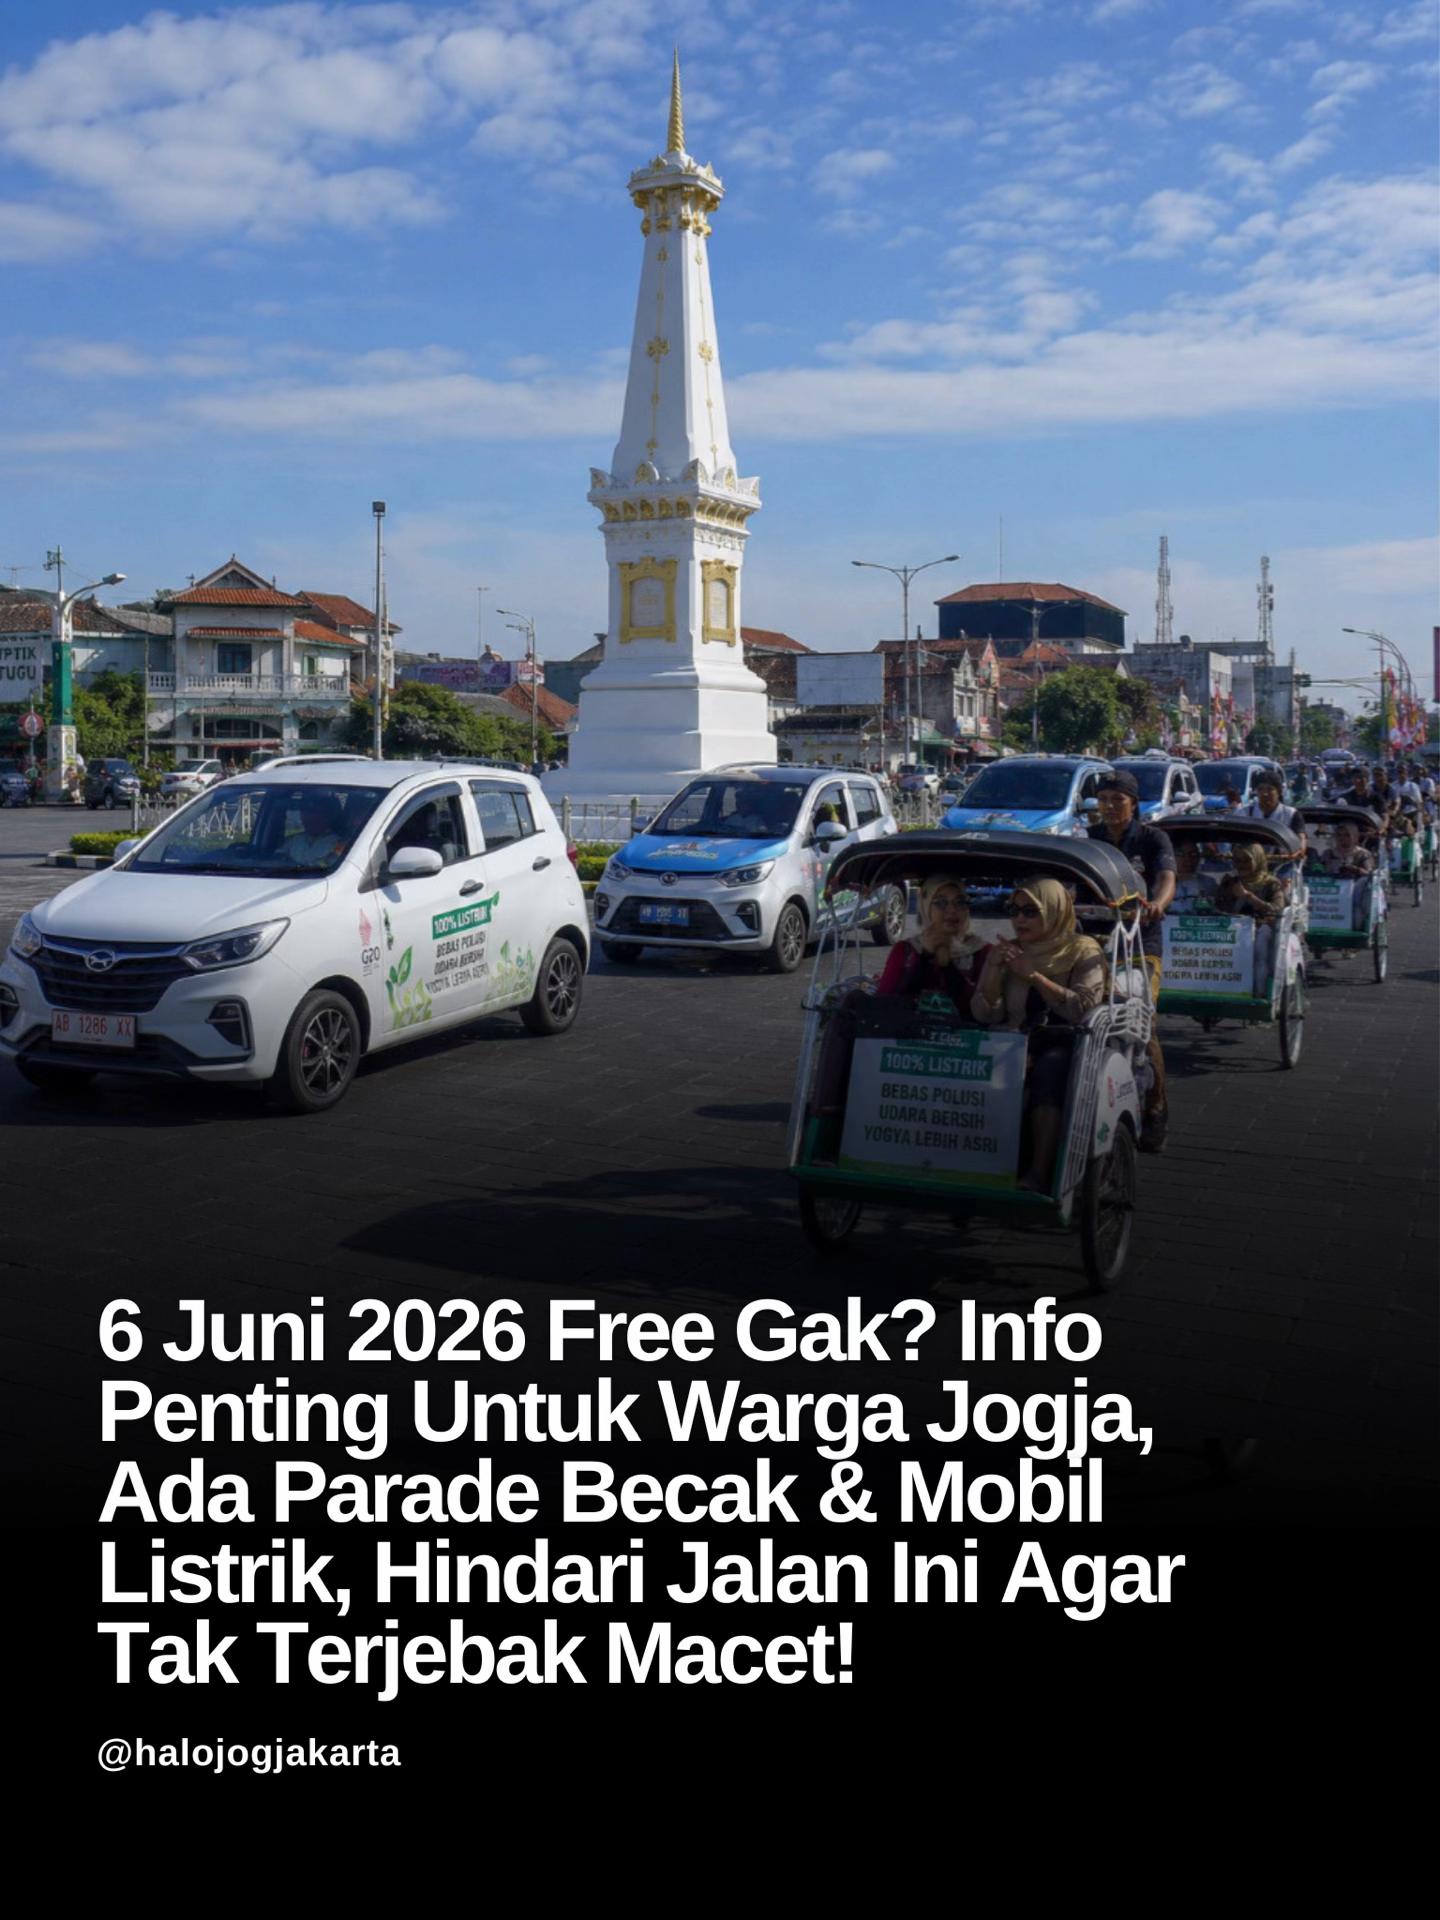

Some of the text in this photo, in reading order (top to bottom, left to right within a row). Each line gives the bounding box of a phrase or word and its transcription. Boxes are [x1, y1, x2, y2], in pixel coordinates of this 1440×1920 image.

[361, 946, 381, 965] G20
[55, 1014, 70, 1033] AB
[79, 1015, 108, 1036] 1286
[886, 1053, 988, 1077] 100% LISTRIK
[881, 1082, 985, 1107] BEBAS POLUSI
[879, 1104, 985, 1129] UDARA BERSIH
[864, 1124, 998, 1153] YOGYA LEBIH ASRI
